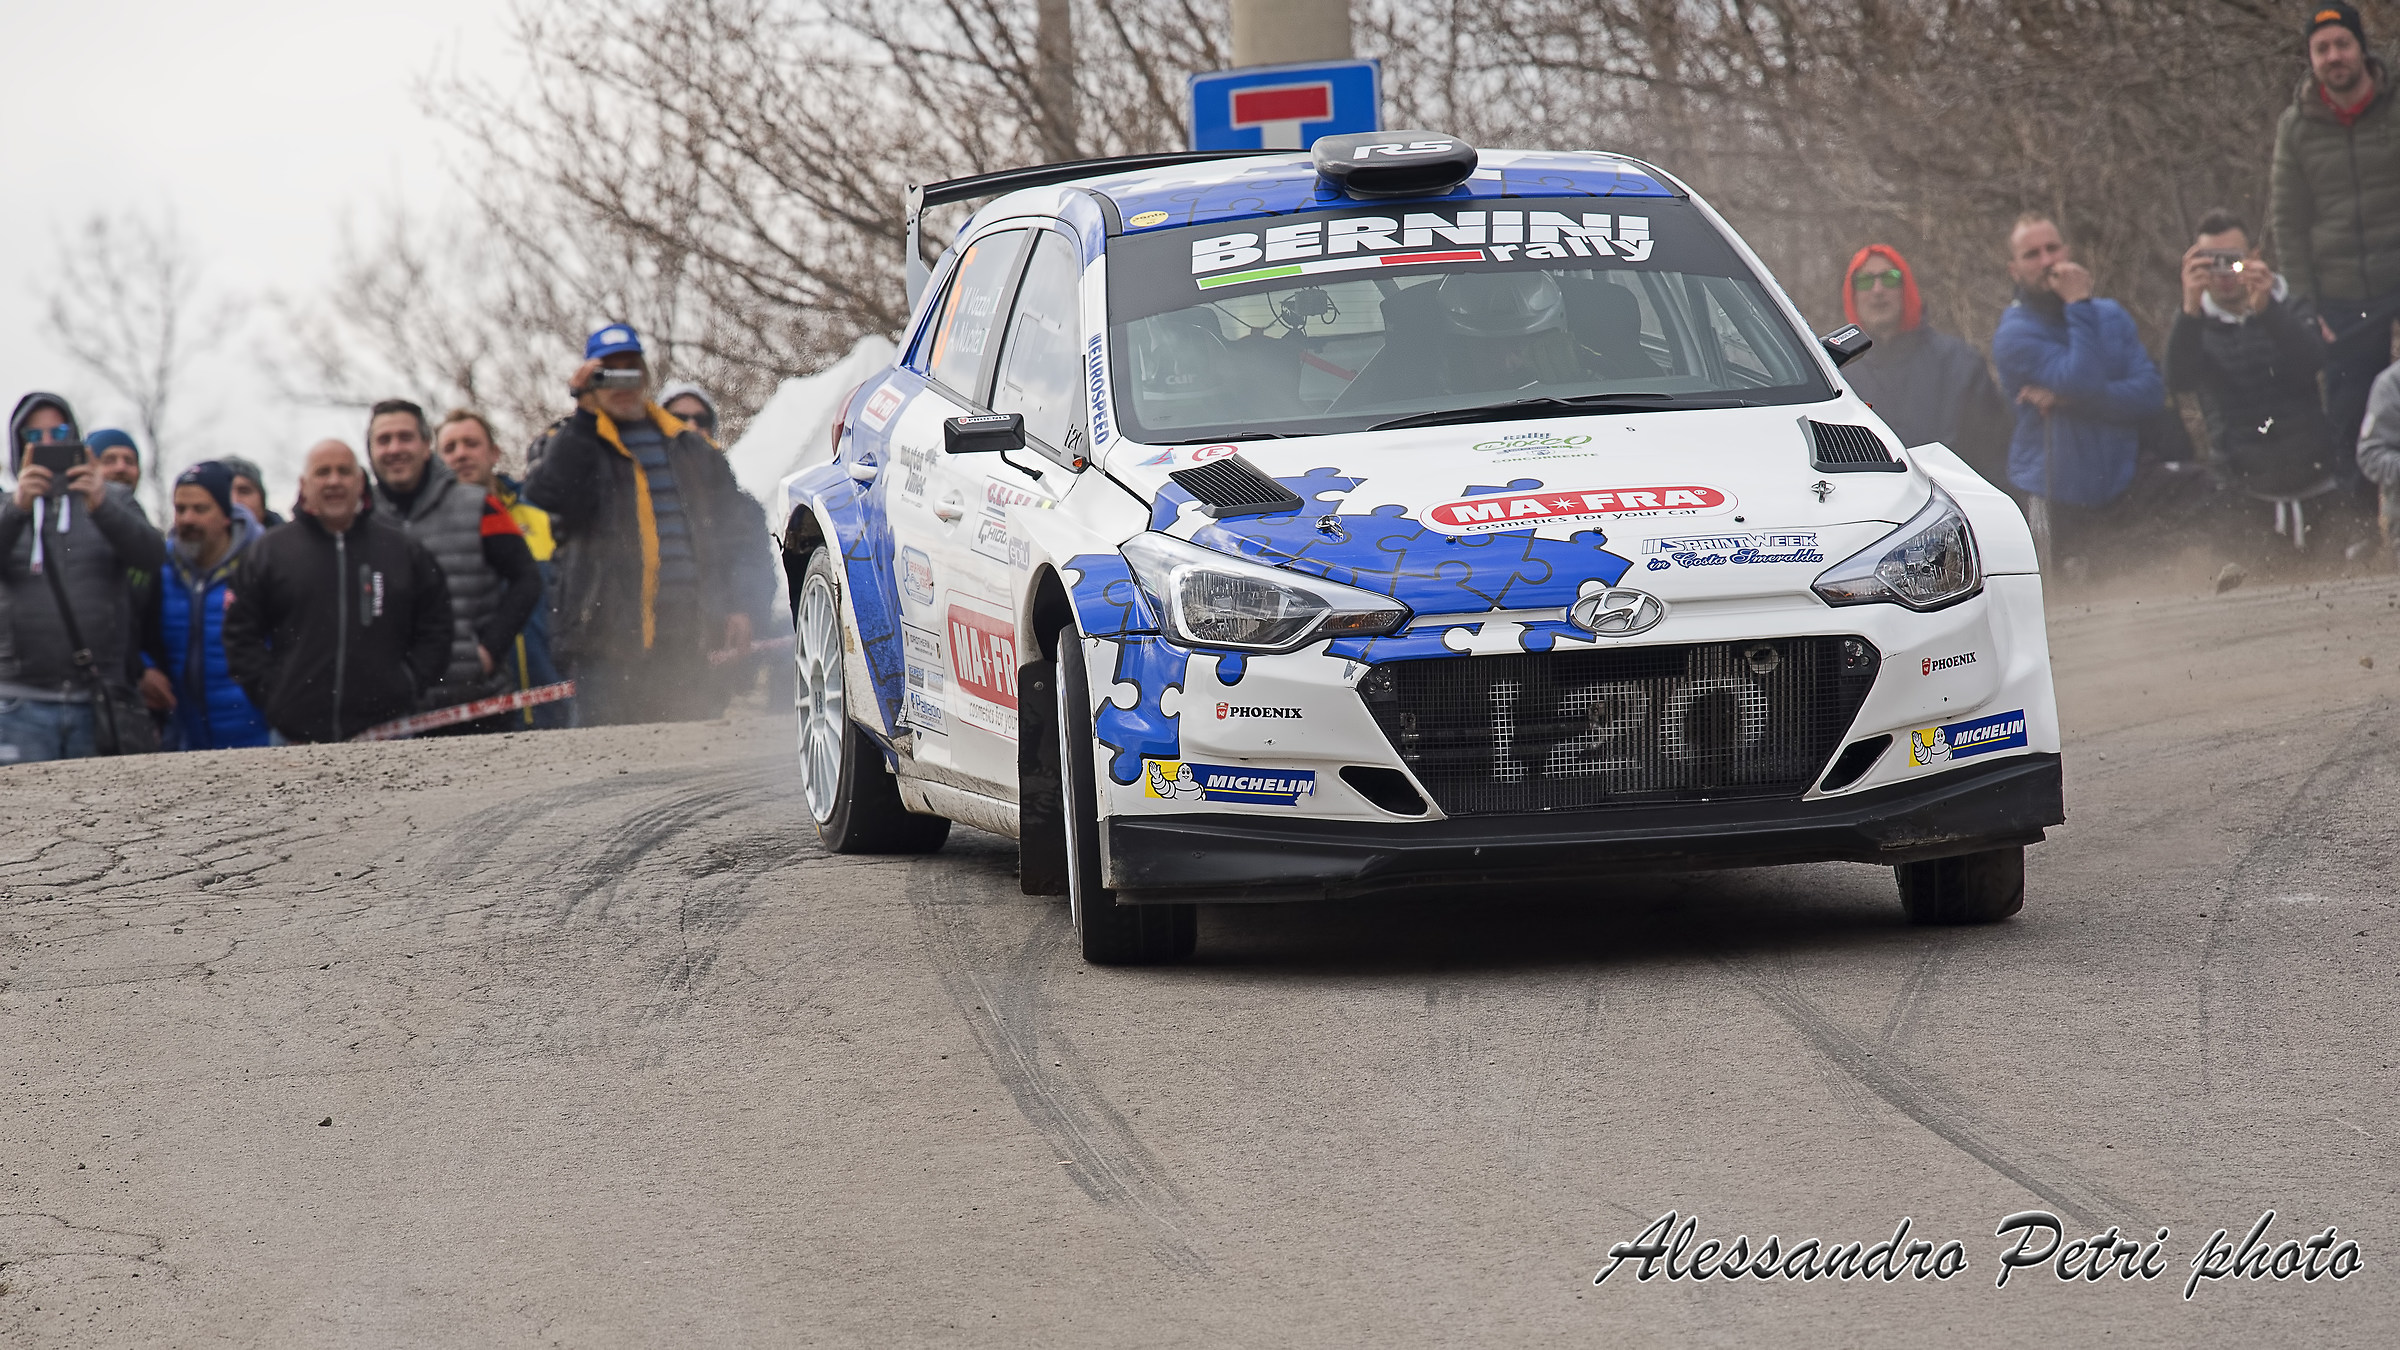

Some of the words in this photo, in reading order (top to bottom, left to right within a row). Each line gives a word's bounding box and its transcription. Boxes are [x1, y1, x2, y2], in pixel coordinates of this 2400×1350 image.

[1353, 140, 1453, 160] R5
[1192, 211, 1650, 275] BERNINI
[1489, 236, 1655, 262] rally
[1088, 343, 1110, 446] EUROSPEED
[1466, 516, 1568, 532] cosmetics
[1574, 513, 1604, 521] for
[1612, 510, 1661, 520] your
[1647, 558, 1671, 571] in
[1671, 552, 1727, 568] Costa
[1729, 549, 1824, 565] Smeralda
[989, 634, 1018, 699] FR
[1931, 651, 1977, 672] PHOENIX
[1229, 706, 1303, 719] PHOENIX
[1954, 719, 2025, 746] MICHELIN
[1206, 774, 1314, 793] MICHELIN
